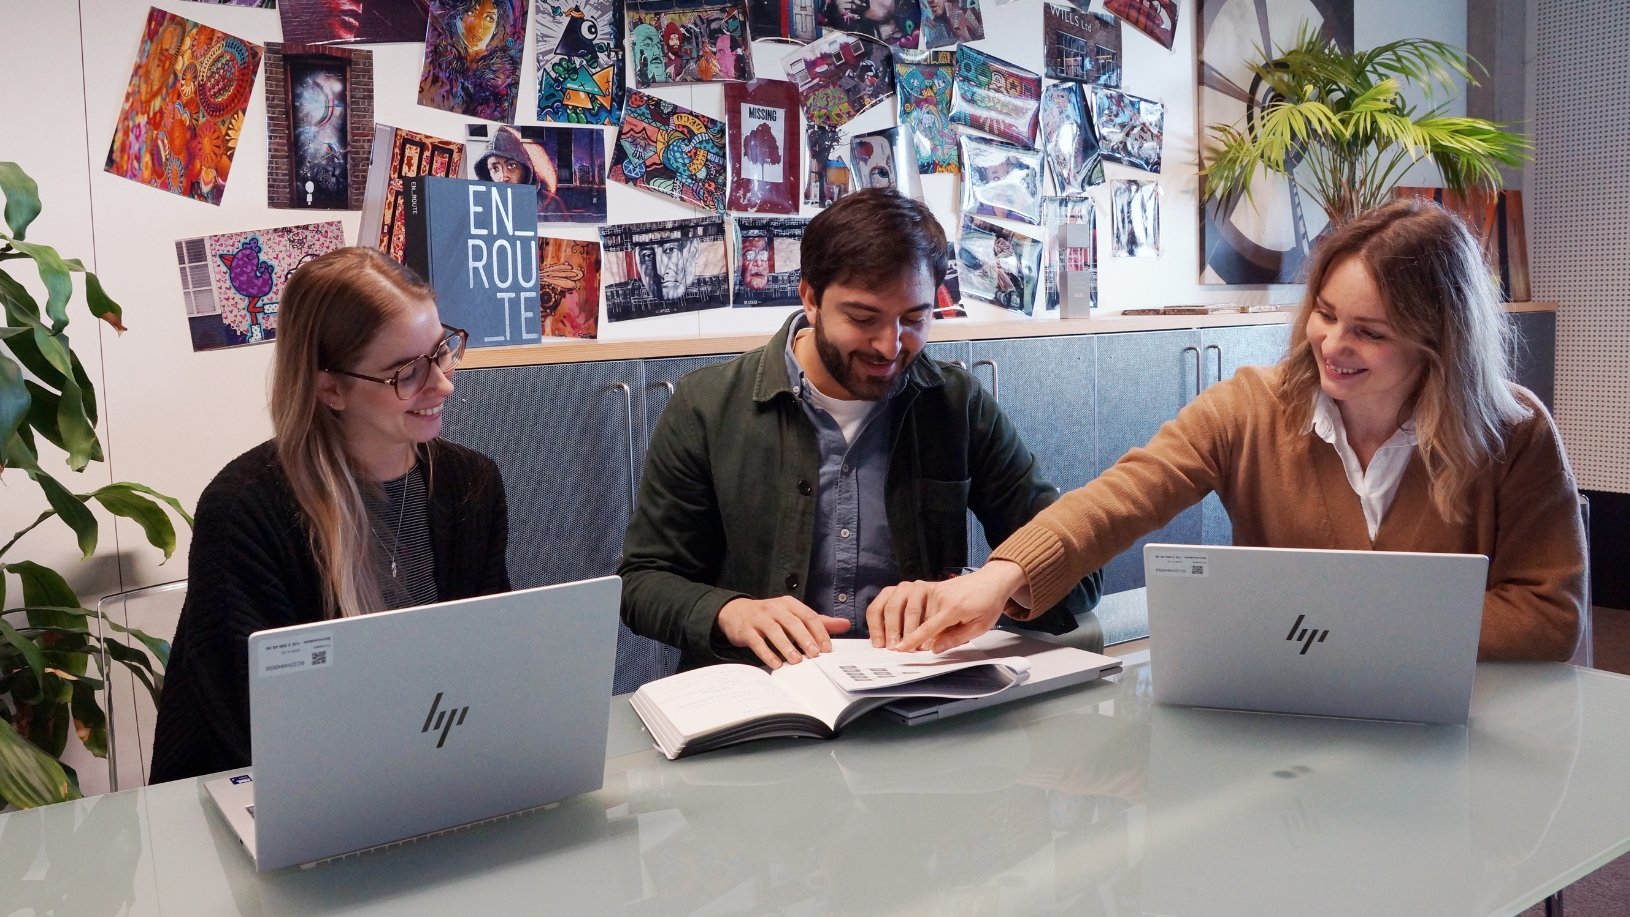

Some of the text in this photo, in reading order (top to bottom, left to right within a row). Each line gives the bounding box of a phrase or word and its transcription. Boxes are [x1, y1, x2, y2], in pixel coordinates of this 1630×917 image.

[1050, 3, 1092, 33] WILLS Ltd
[748, 106, 777, 122] MISSING
[467, 238, 537, 289] ROU
[1285, 614, 1330, 656] hp
[420, 691, 470, 749] hp
